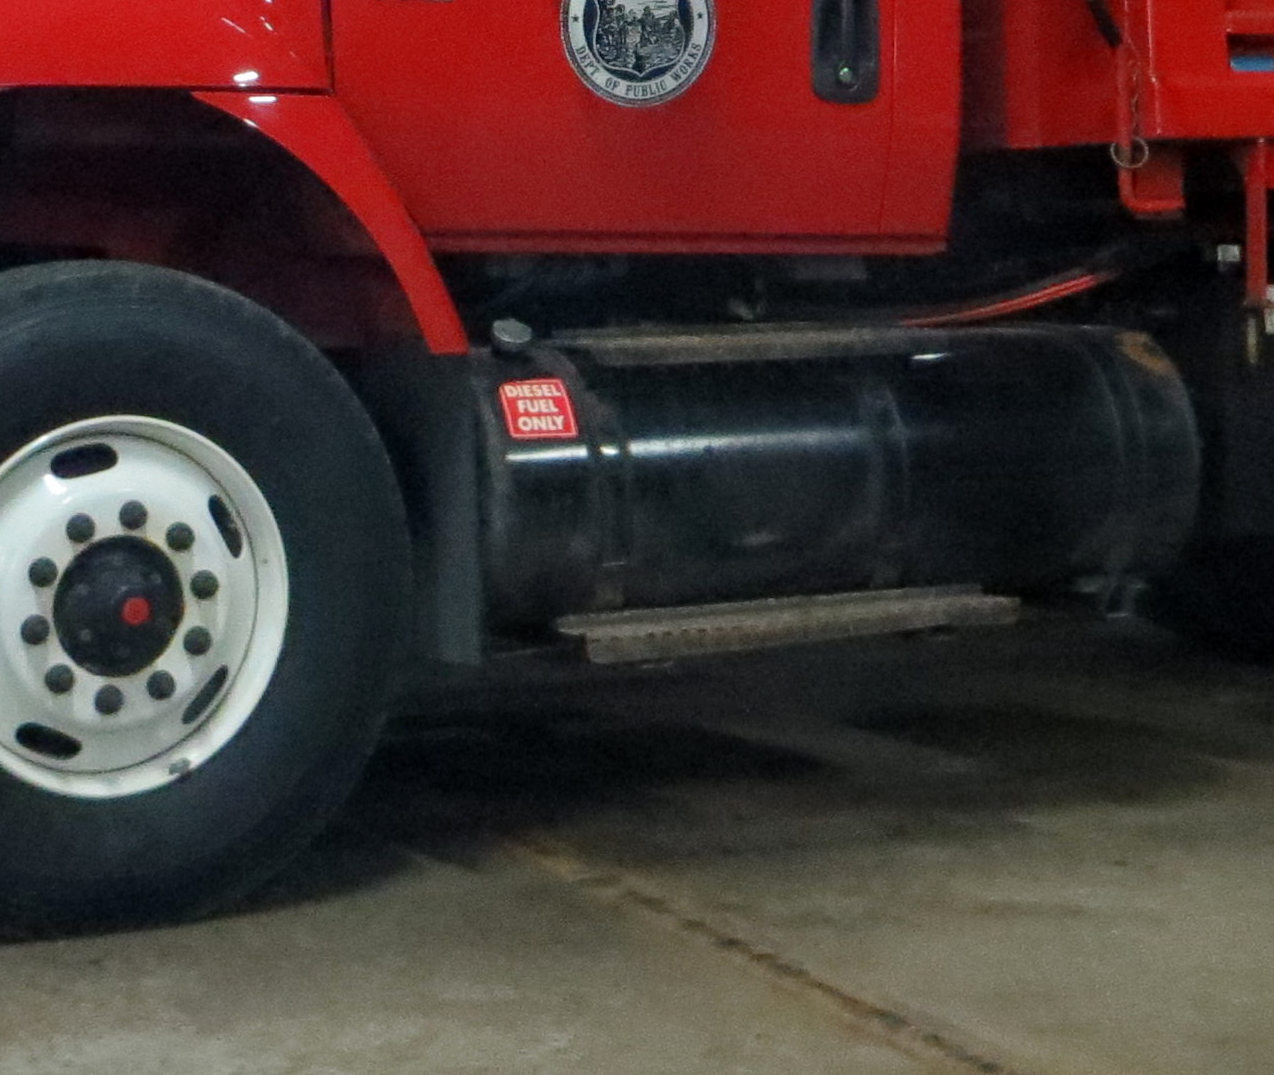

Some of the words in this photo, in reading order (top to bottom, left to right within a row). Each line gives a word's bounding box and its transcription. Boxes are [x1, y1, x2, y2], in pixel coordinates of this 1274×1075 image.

[575, 45, 600, 76] DEPT
[605, 77, 621, 91] OF
[625, 80, 668, 98] PUBLIC
[671, 42, 702, 83] WORKS
[505, 384, 561, 397] DIESEL
[517, 399, 559, 413] FUEL
[518, 415, 565, 431] ONLY
